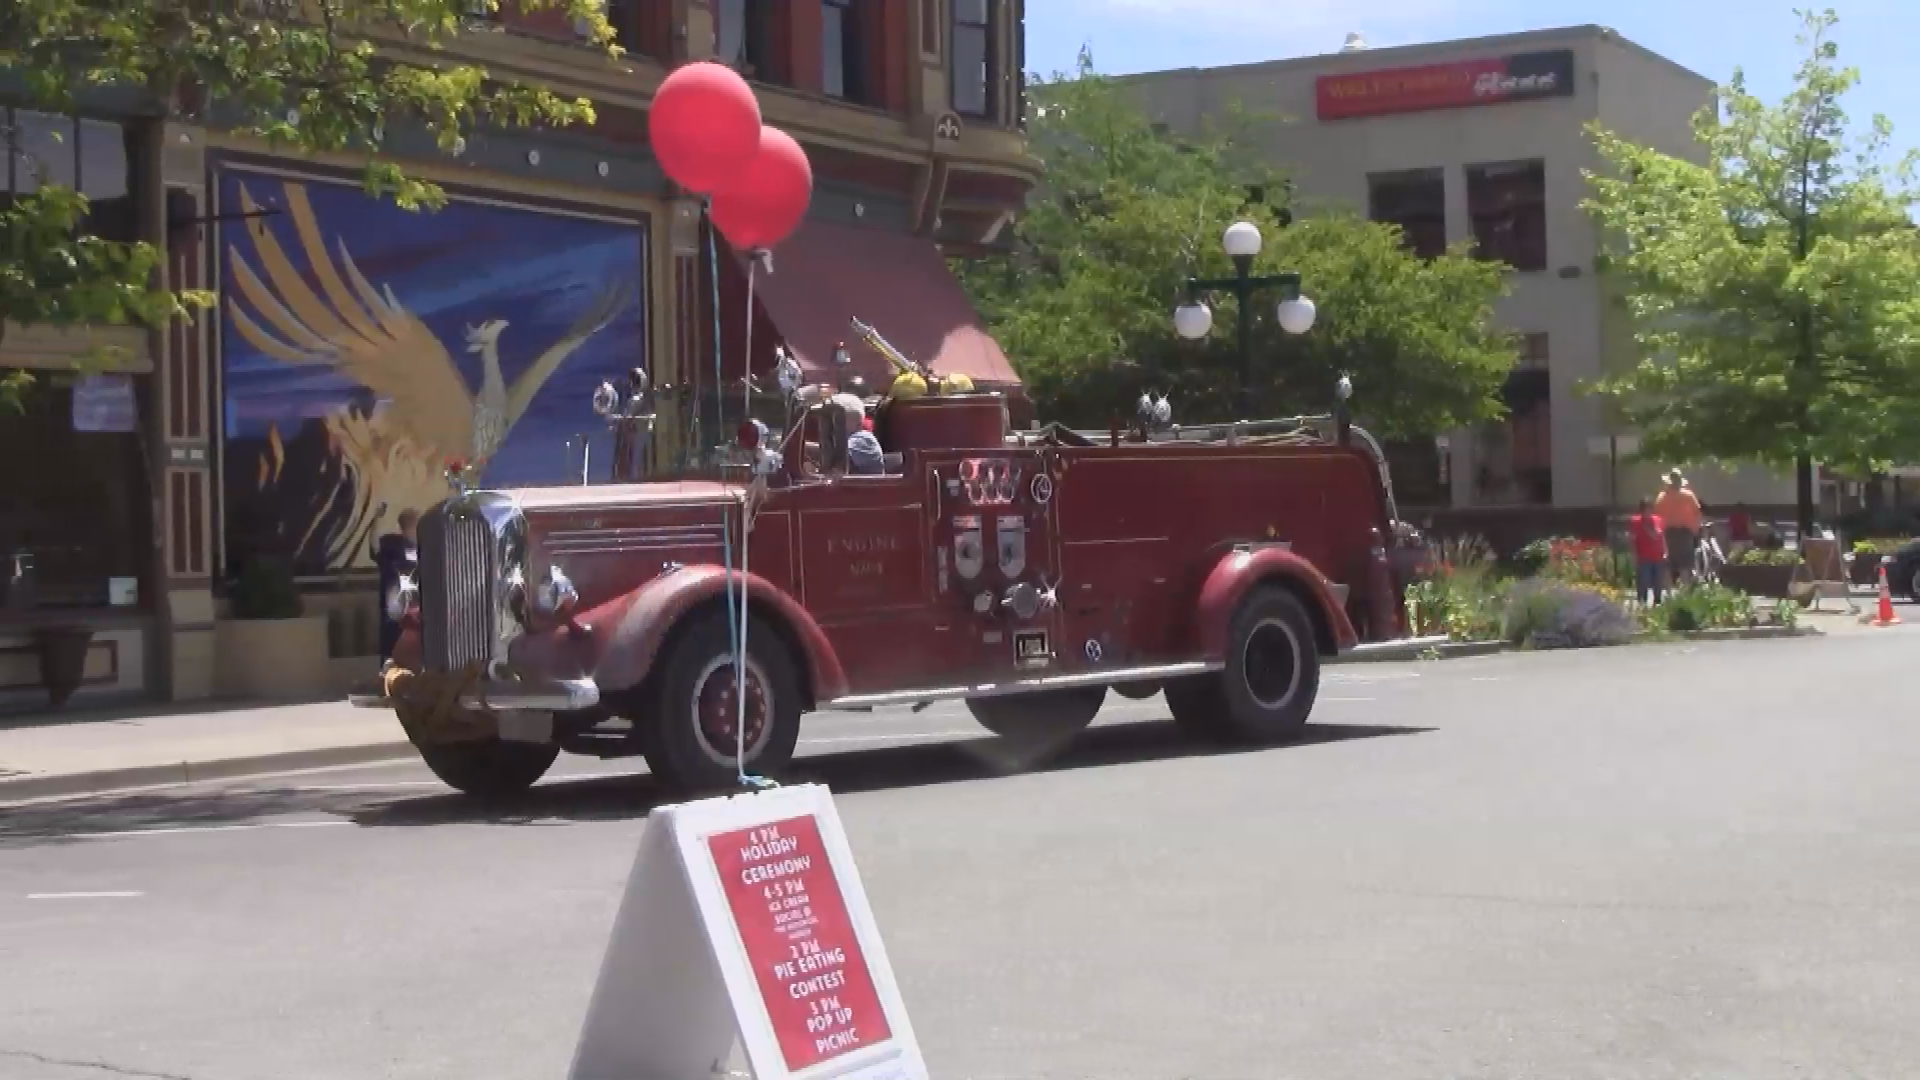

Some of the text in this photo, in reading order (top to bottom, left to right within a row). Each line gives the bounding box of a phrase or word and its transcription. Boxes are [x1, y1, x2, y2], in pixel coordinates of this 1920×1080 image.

[760, 825, 780, 843] PM
[740, 835, 798, 862] HOLIDAY
[741, 855, 811, 885] CEREMONY
[785, 878, 805, 895] PM
[800, 938, 820, 956] PM
[774, 947, 846, 981] PIE EATING
[789, 969, 846, 999] CONTEST
[820, 995, 841, 1013] PM
[806, 1007, 853, 1033] POP UP
[815, 1027, 860, 1054] PICNIC
